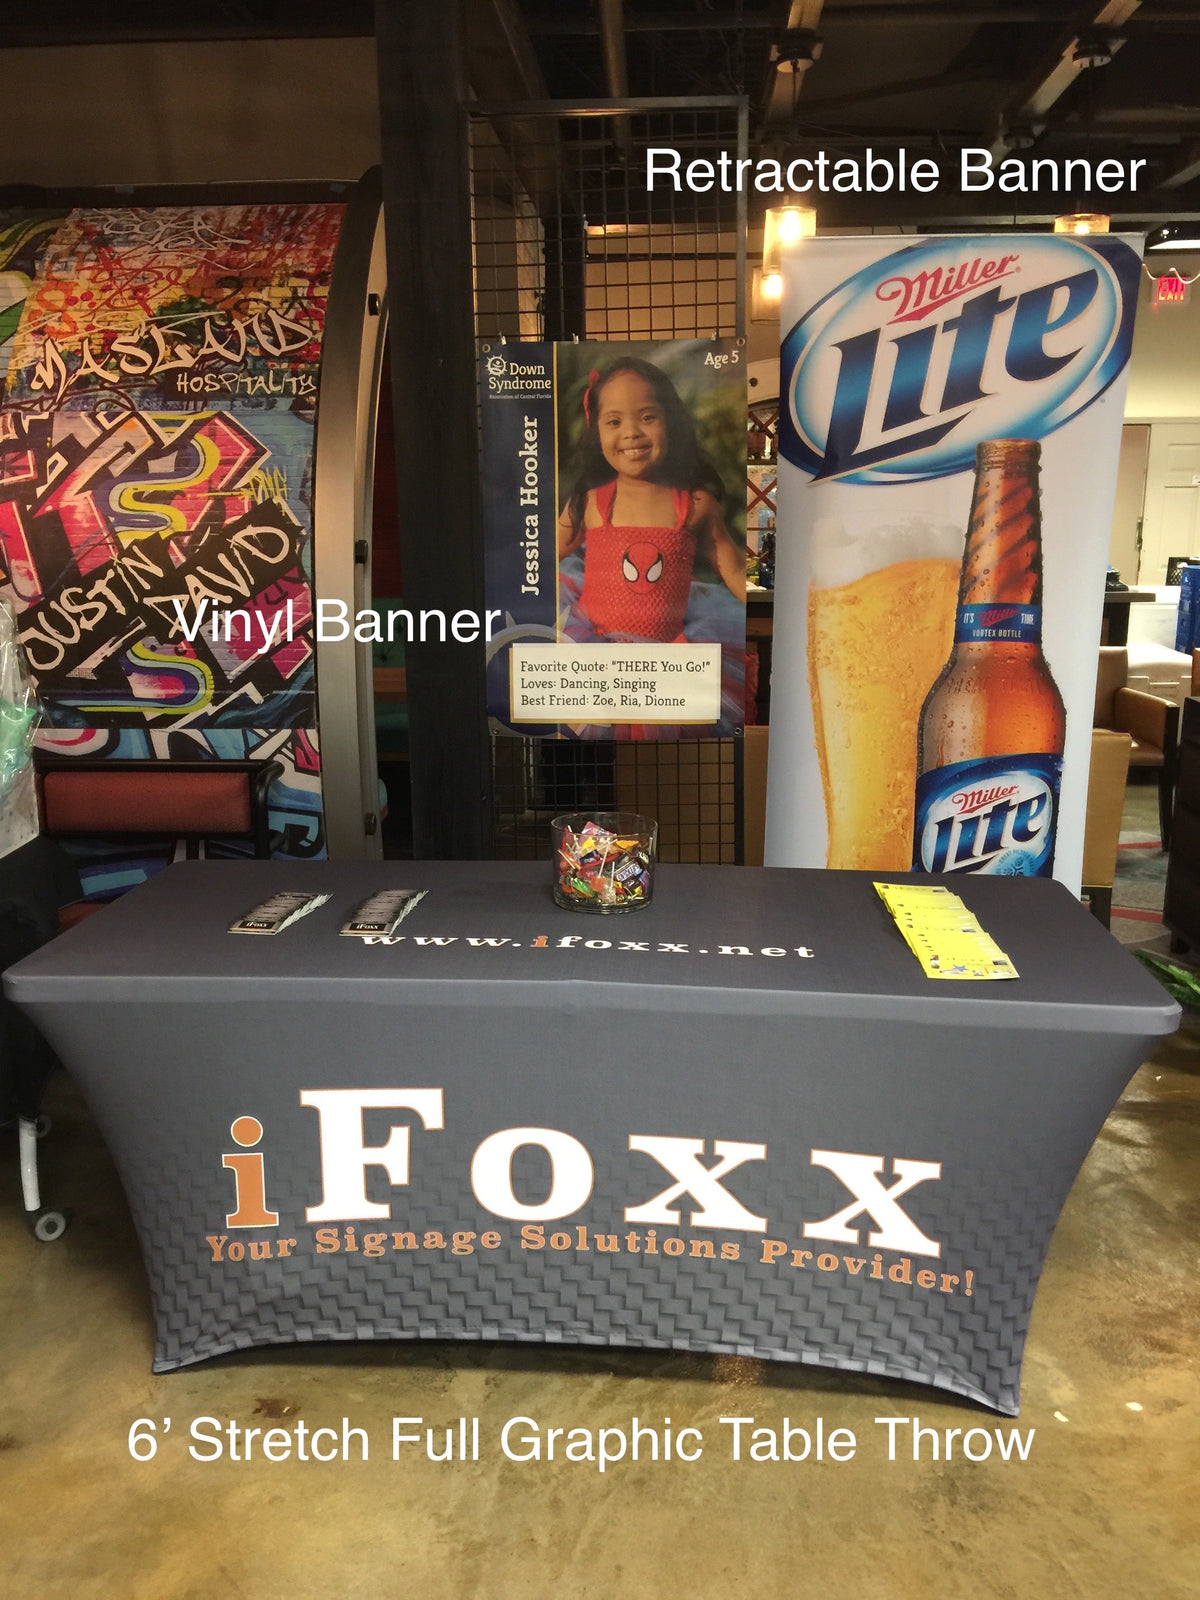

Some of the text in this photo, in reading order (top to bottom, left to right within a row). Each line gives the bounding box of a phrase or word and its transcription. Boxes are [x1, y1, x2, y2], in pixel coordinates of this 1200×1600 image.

[876, 254, 1020, 325] Miller
[30, 309, 314, 403] MASLAND
[509, 362, 546, 376] Down
[704, 350, 739, 369] Age 5
[176, 369, 318, 396] HOSPITALITY
[488, 376, 552, 394] Syndrome
[808, 267, 1100, 487] Lite
[518, 415, 541, 597] Jessica Hooker
[17, 544, 165, 671] JUSTIN
[520, 660, 711, 675] Favorite Quote: "THERE You Go!"
[520, 677, 657, 692] Loves: Dancing, Singing
[521, 694, 686, 707] Best Friend: Zoe, Ria, Dionne
[952, 784, 1019, 815] Miller
[930, 791, 1047, 875] Lite
[361, 935, 815, 959] www.ifoxx.net
[222, 1087, 943, 1259] iFoxx
[206, 1224, 975, 1297] Your Signage Solutions Provider!
